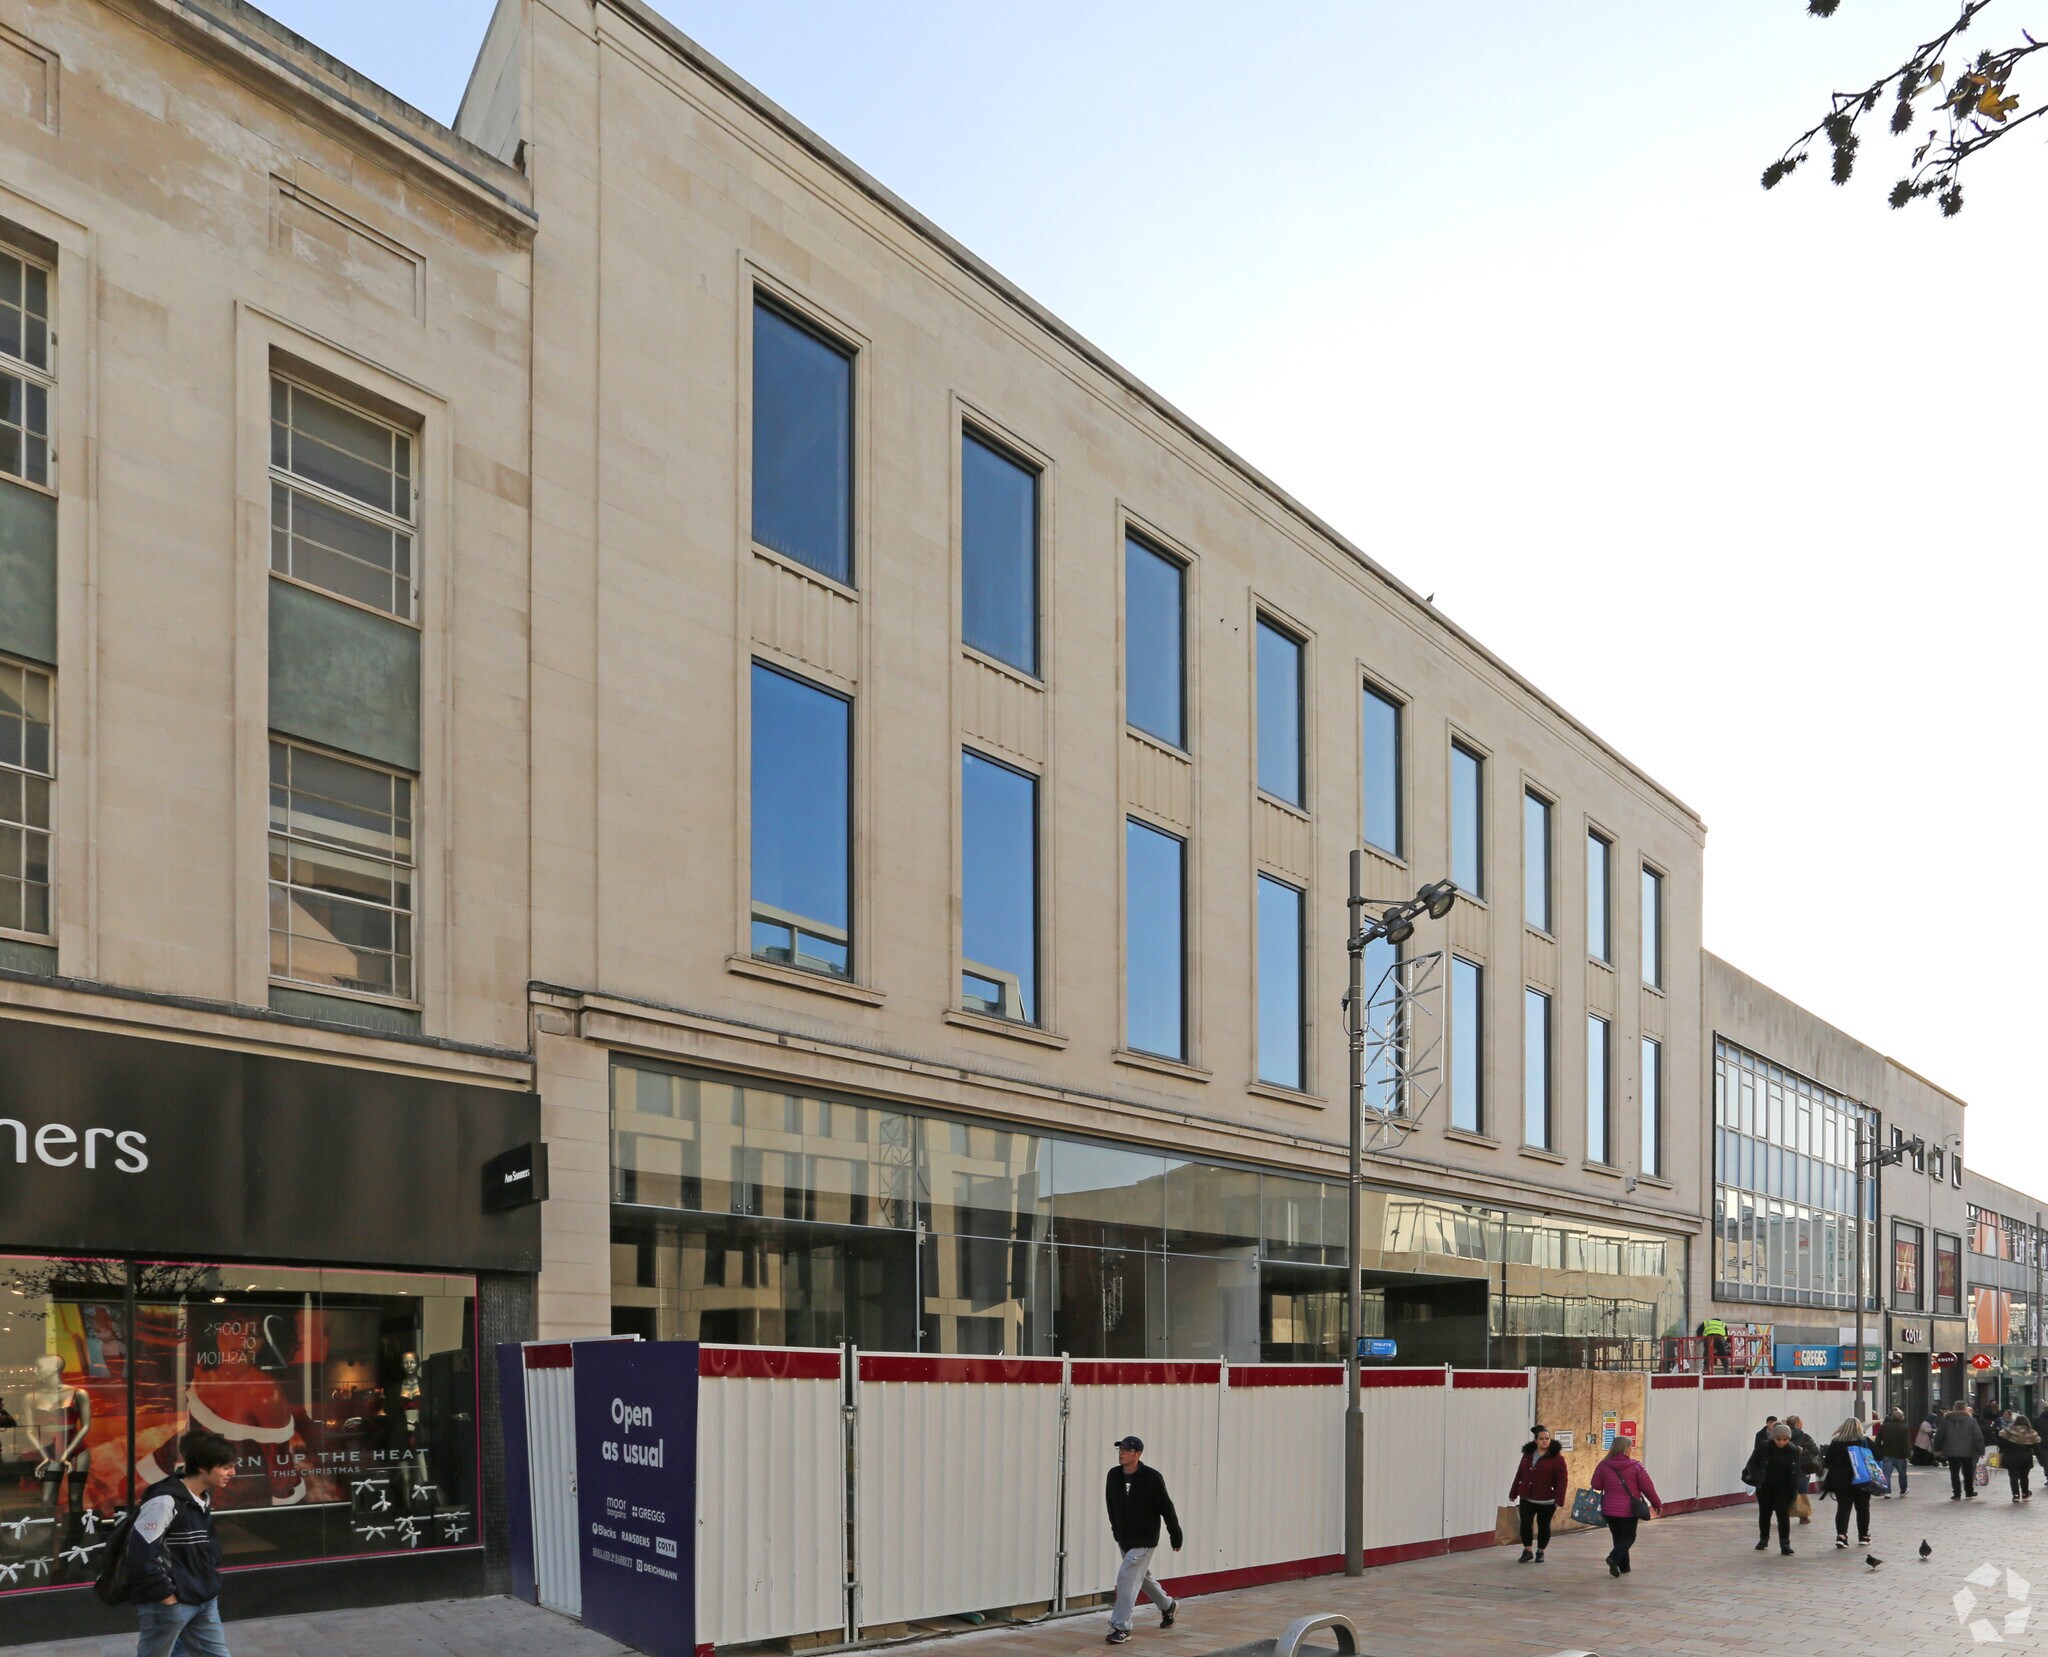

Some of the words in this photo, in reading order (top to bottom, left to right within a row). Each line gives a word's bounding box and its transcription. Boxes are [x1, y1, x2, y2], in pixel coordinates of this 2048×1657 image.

[1905, 1328, 1922, 1344] COSTA
[1801, 1350, 1827, 1366] GREGGS
[611, 1397, 652, 1434] Open
[236, 1455, 262, 1468] RN
[276, 1454, 306, 1466] UP
[318, 1451, 360, 1463] THE
[373, 1449, 429, 1461] HEAT
[602, 1440, 619, 1462] as
[623, 1438, 664, 1468] usual
[272, 1470, 297, 1478] THIS
[301, 1466, 361, 1477] CHRISTMAS
[638, 1507, 666, 1523] GREGGS
[598, 1524, 617, 1539] Blacks
[657, 1541, 675, 1552] COSTA
[643, 1563, 678, 1580] DEICHMANN
